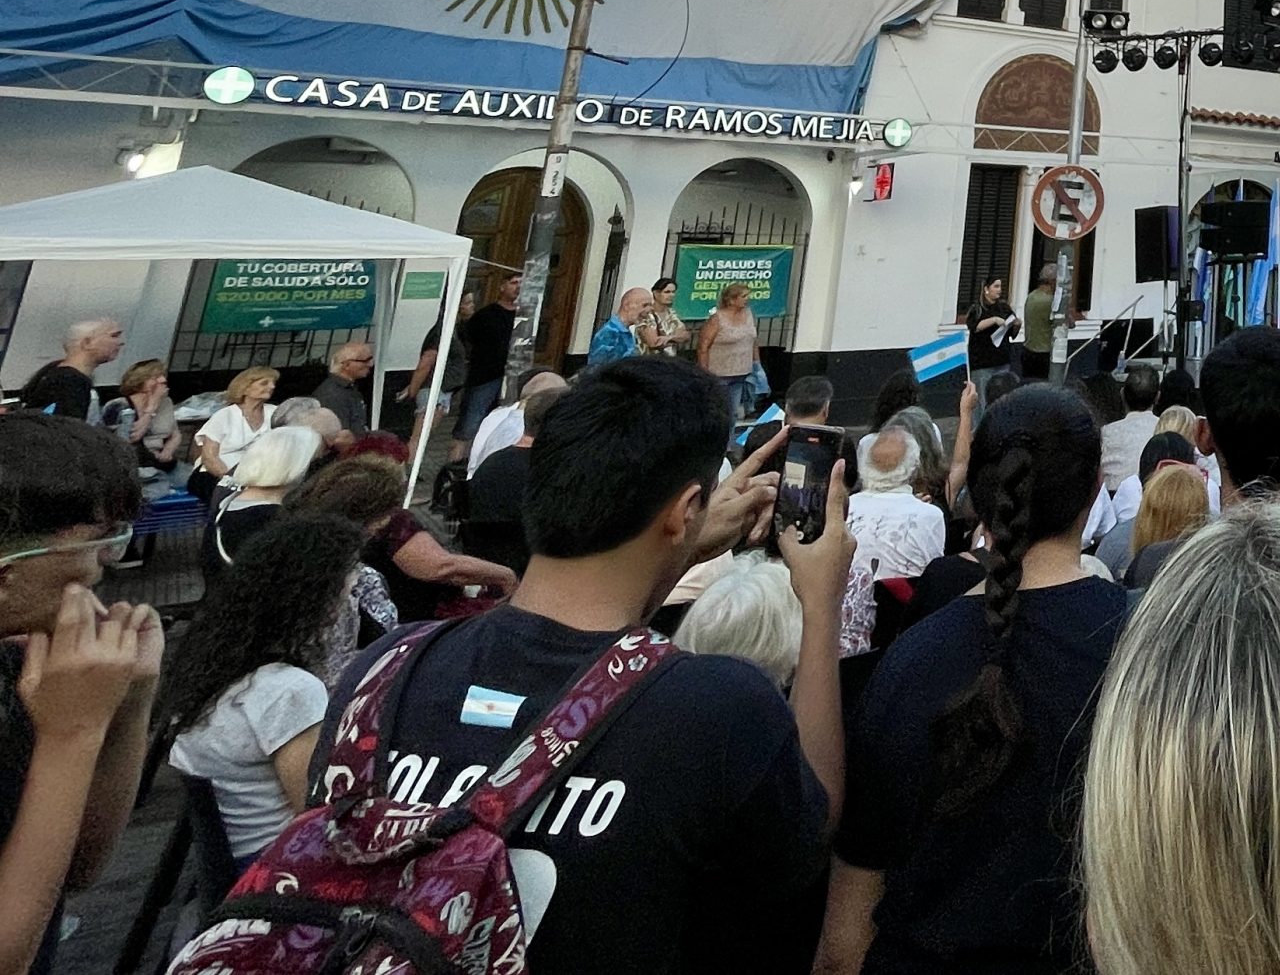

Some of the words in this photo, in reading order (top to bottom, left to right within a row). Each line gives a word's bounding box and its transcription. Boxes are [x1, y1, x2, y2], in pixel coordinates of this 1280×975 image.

[265, 75, 390, 110] CASA
[401, 91, 442, 112] DE
[452, 89, 604, 123] AUXILO
[619, 107, 654, 127] DE
[664, 105, 783, 136] RAMOS
[237, 263, 258, 274] TU
[261, 262, 364, 274] COBERTURA
[698, 260, 714, 270] LA
[716, 260, 756, 270] SALUD
[757, 260, 773, 270] ES
[223, 277, 249, 288] DE
[251, 276, 307, 288] SALUD
[309, 276, 322, 286] A
[324, 273, 370, 286] SÓLO
[695, 270, 714, 280] UN
[714, 270, 772, 280] DERECHO
[291, 291, 329, 302] POR
[330, 289, 367, 301] MES
[690, 291, 717, 301] POR
